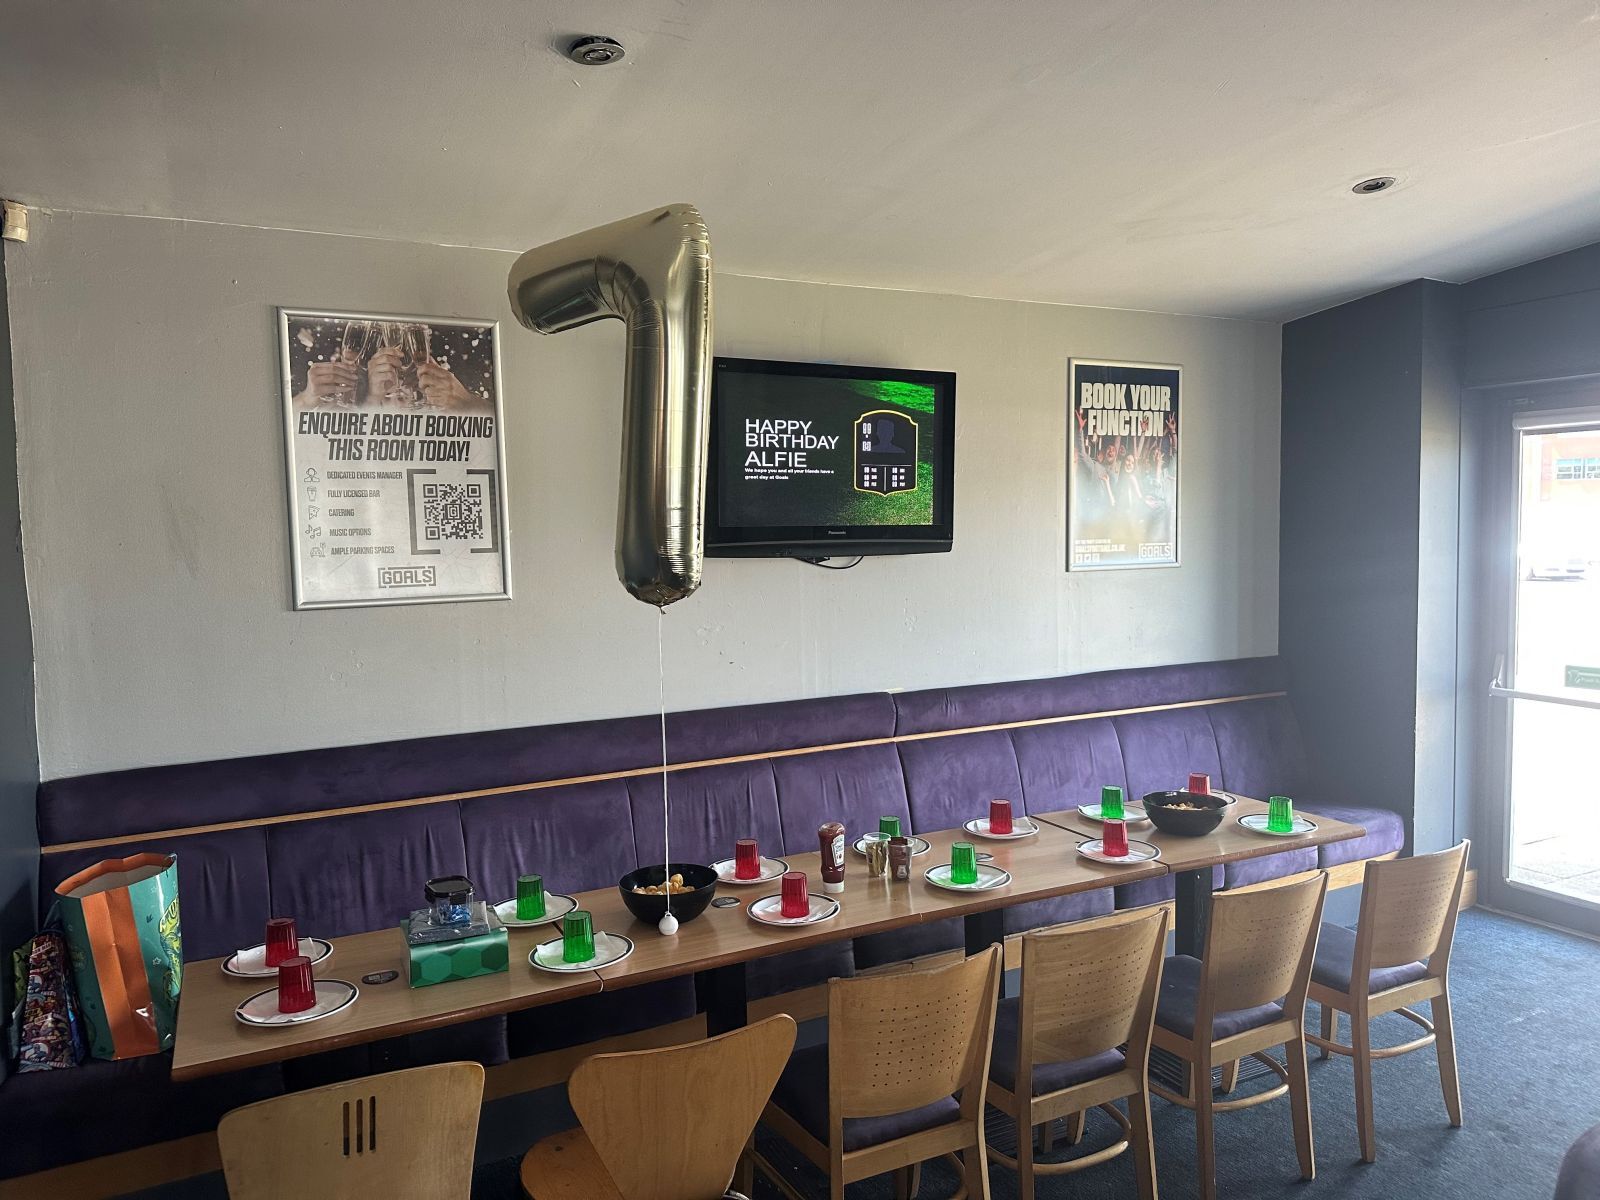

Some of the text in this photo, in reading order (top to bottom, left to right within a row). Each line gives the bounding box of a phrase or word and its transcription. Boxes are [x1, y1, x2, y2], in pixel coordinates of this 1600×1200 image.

[1081, 382, 1170, 411] BOOK YOUR
[298, 412, 494, 438] ENQUIRE ABOUT BOOKING
[745, 418, 812, 436] HAPPY
[1088, 410, 1164, 436] FUNCTION
[328, 438, 470, 462] THIS ROOM TODAY!
[745, 433, 840, 450] BIRTHDAY
[744, 452, 807, 468] ALFIE
[327, 471, 355, 479] DEDICATED
[348, 528, 372, 536] OPTIONS
[1141, 546, 1170, 558] GOALS
[382, 570, 433, 585] GOALS
